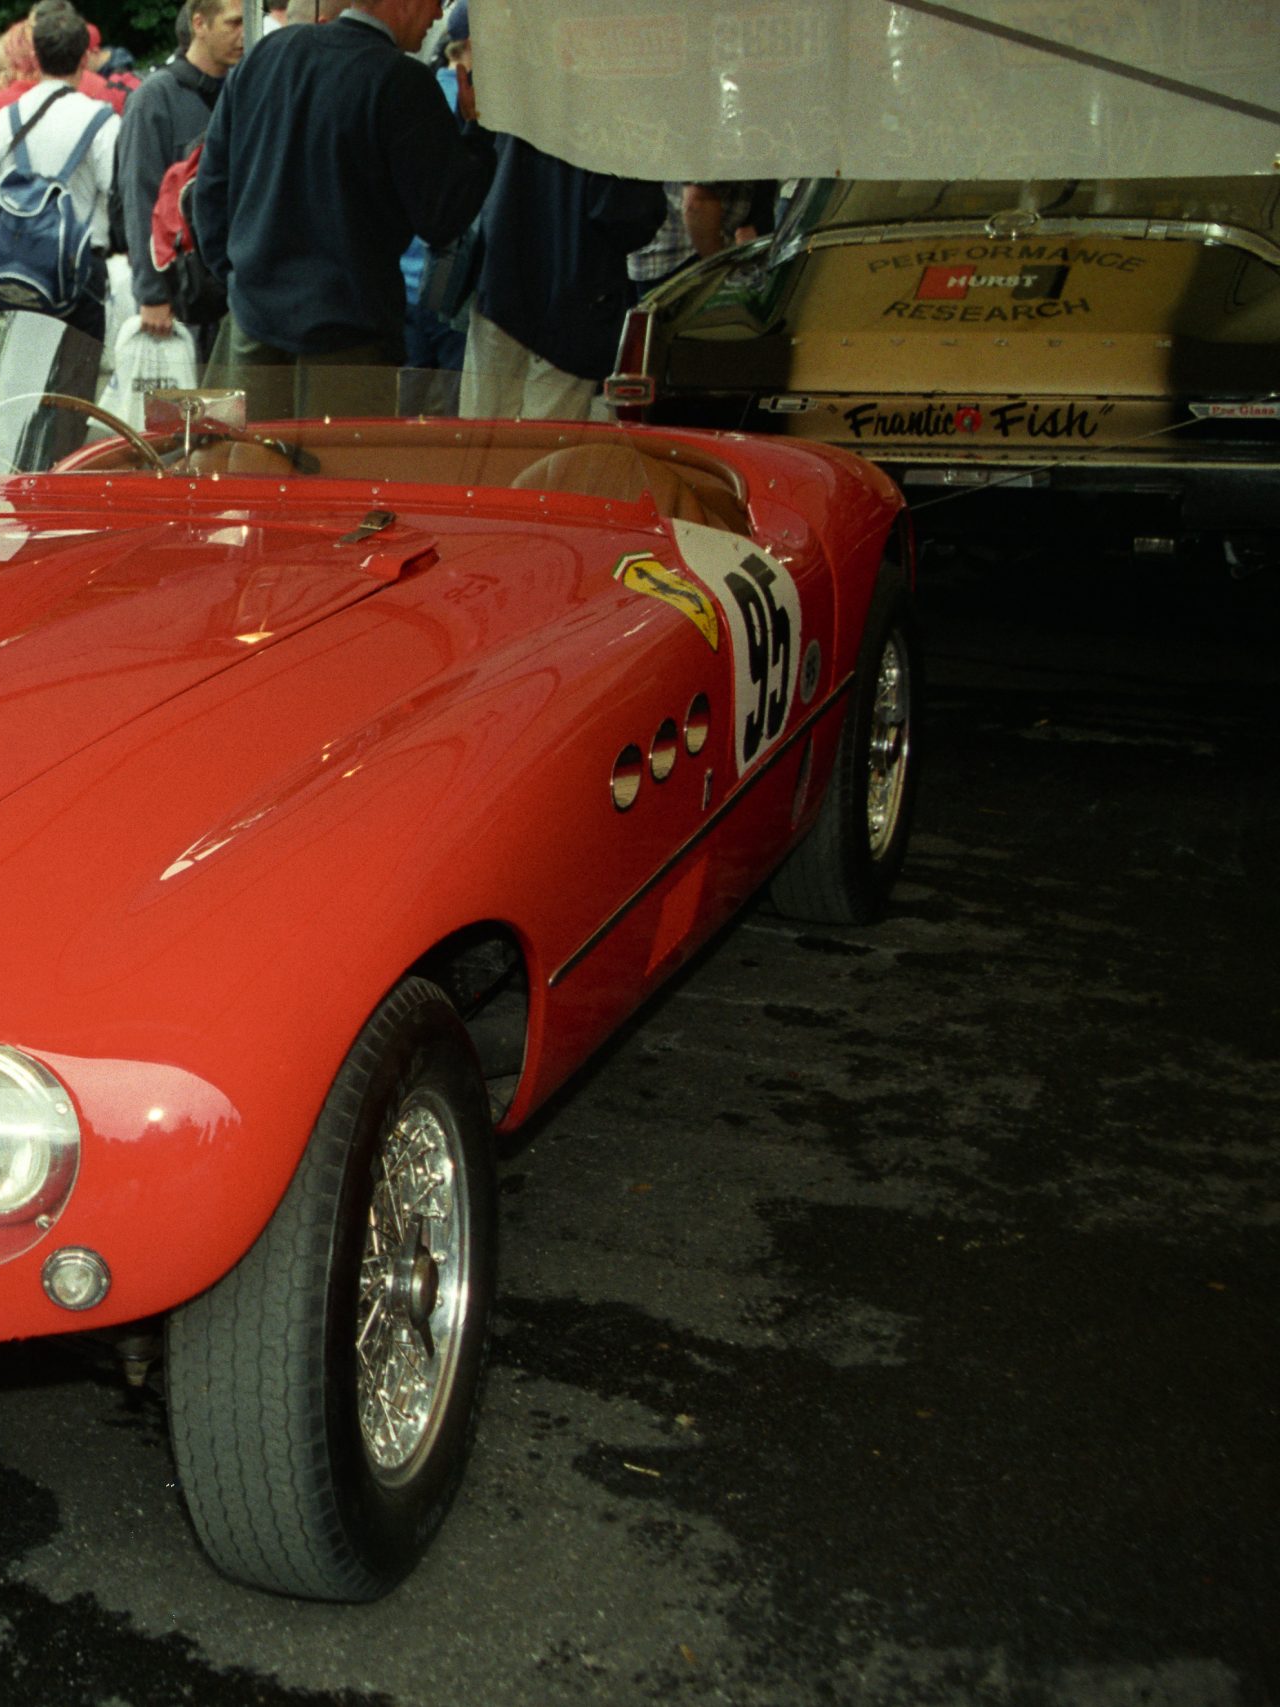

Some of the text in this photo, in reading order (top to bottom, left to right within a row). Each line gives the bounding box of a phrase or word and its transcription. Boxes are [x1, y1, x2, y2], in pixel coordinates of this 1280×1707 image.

[869, 245, 1146, 273] PERFORMANCE
[946, 274, 1039, 289] HURST
[882, 298, 1091, 323] RESEARCH
[724, 553, 791, 763] 95
